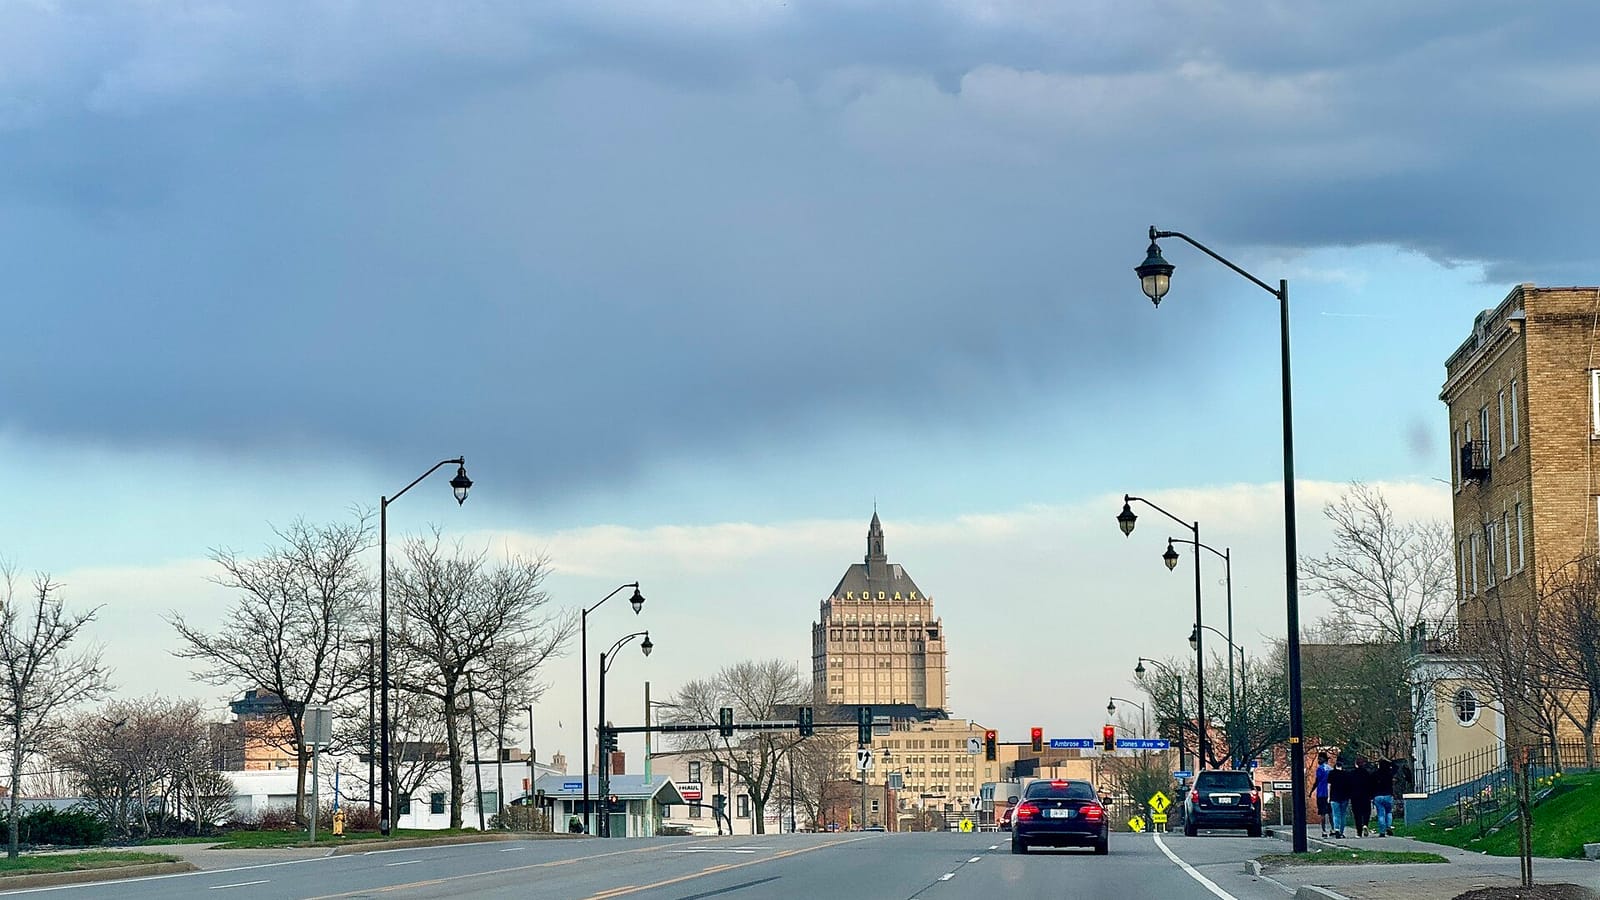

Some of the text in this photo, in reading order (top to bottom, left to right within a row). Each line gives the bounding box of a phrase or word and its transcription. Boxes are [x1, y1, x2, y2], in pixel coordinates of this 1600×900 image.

[846, 591, 917, 600] KODAK
[1120, 740, 1154, 748] Jones Ave
